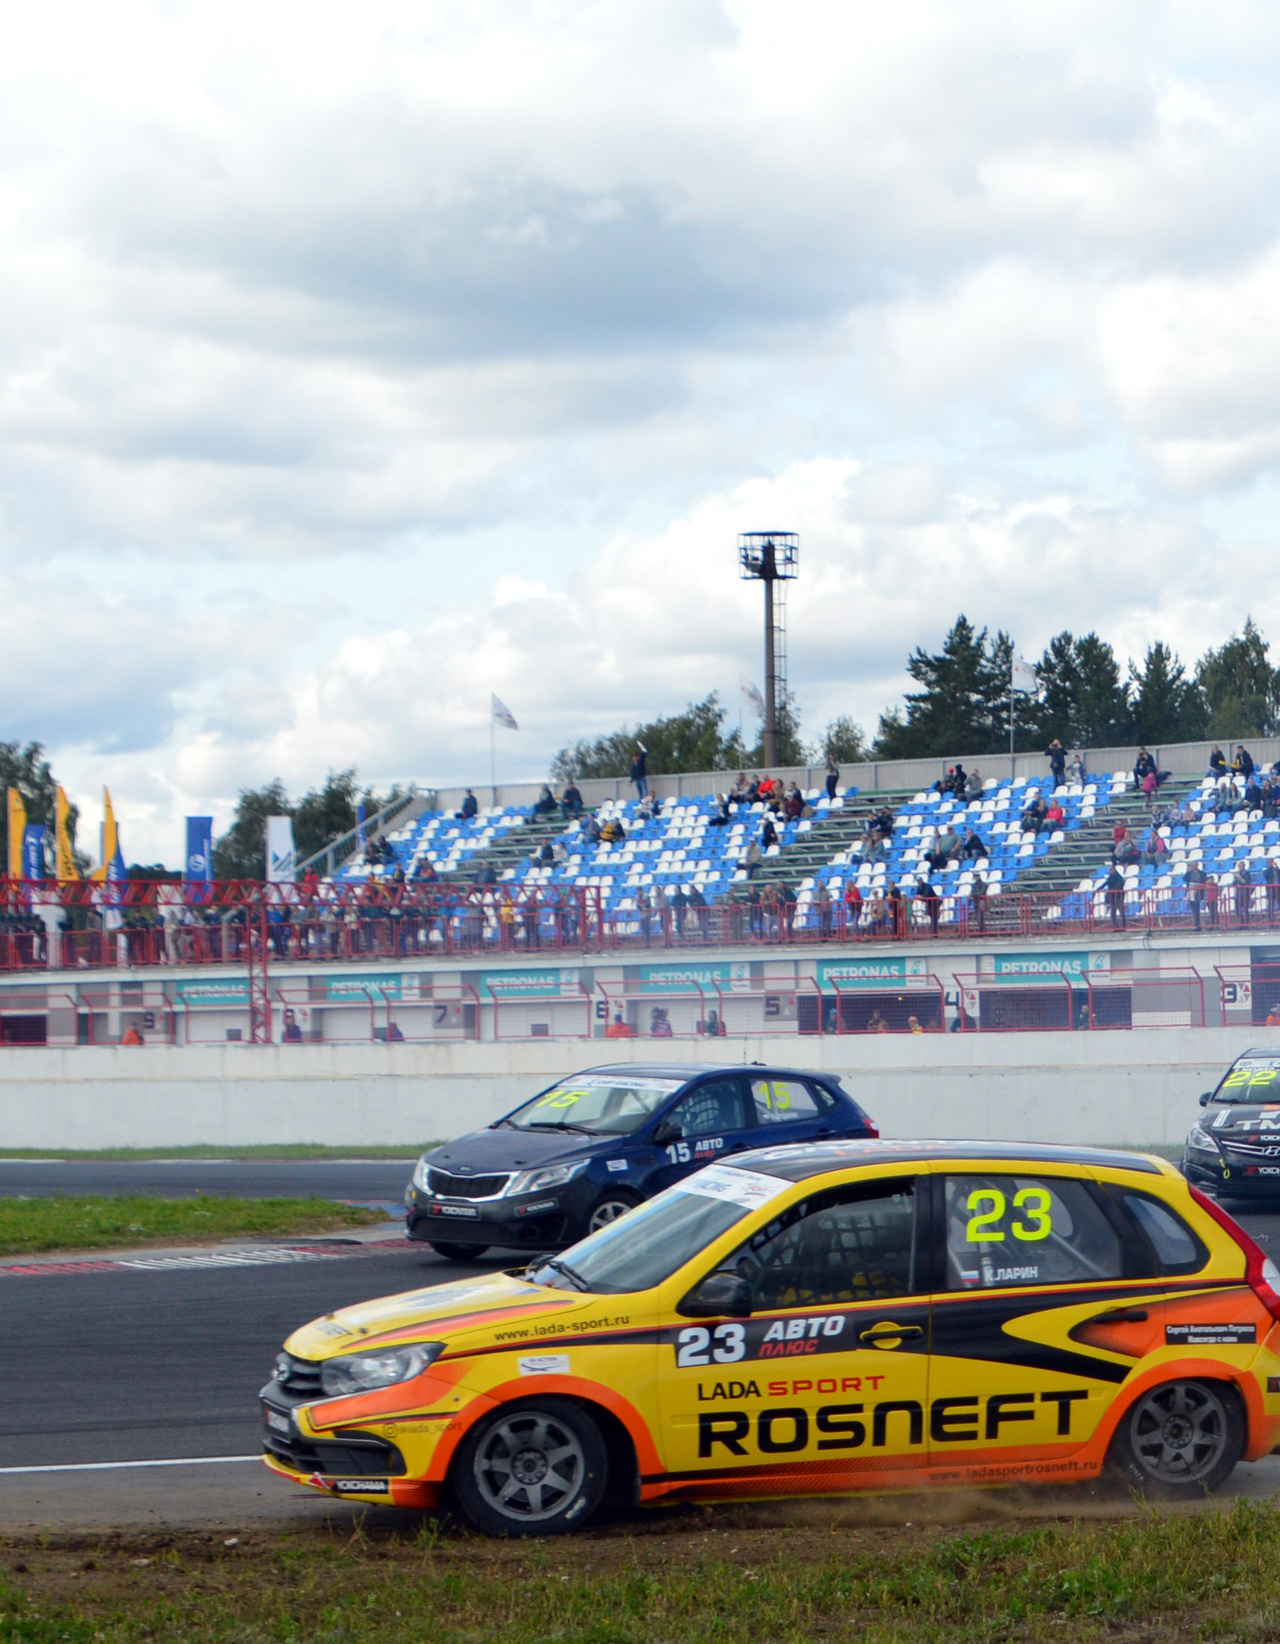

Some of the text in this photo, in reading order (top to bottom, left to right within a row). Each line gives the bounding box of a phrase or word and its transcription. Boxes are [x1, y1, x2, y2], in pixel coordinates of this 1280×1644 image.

[823, 965, 899, 980] PETRONAS
[1001, 960, 1082, 975] PETRONAS
[331, 979, 397, 995] PETRONAS
[486, 976, 555, 990] PETRONAS
[650, 971, 722, 986] PETRONAS
[434, 1004, 447, 1023] 7
[596, 1000, 609, 1019] 6
[765, 996, 780, 1015] 5
[1222, 1071, 1278, 1088] 22
[535, 1090, 589, 1108] 15
[759, 1083, 790, 1109] 15
[665, 1142, 691, 1164] 15
[695, 1138, 723, 1151] АВТО
[965, 1188, 1052, 1242] 23
[494, 1315, 630, 1341] www.lada-sport.ru
[763, 1315, 846, 1342] АВТО
[677, 1323, 746, 1367] 23
[758, 1339, 819, 1357] ПЛЮС
[698, 1375, 885, 1401] LADA SPORT
[698, 1390, 1088, 1458] ROSNEFT
[337, 1480, 386, 1491] YOKOHAMA
